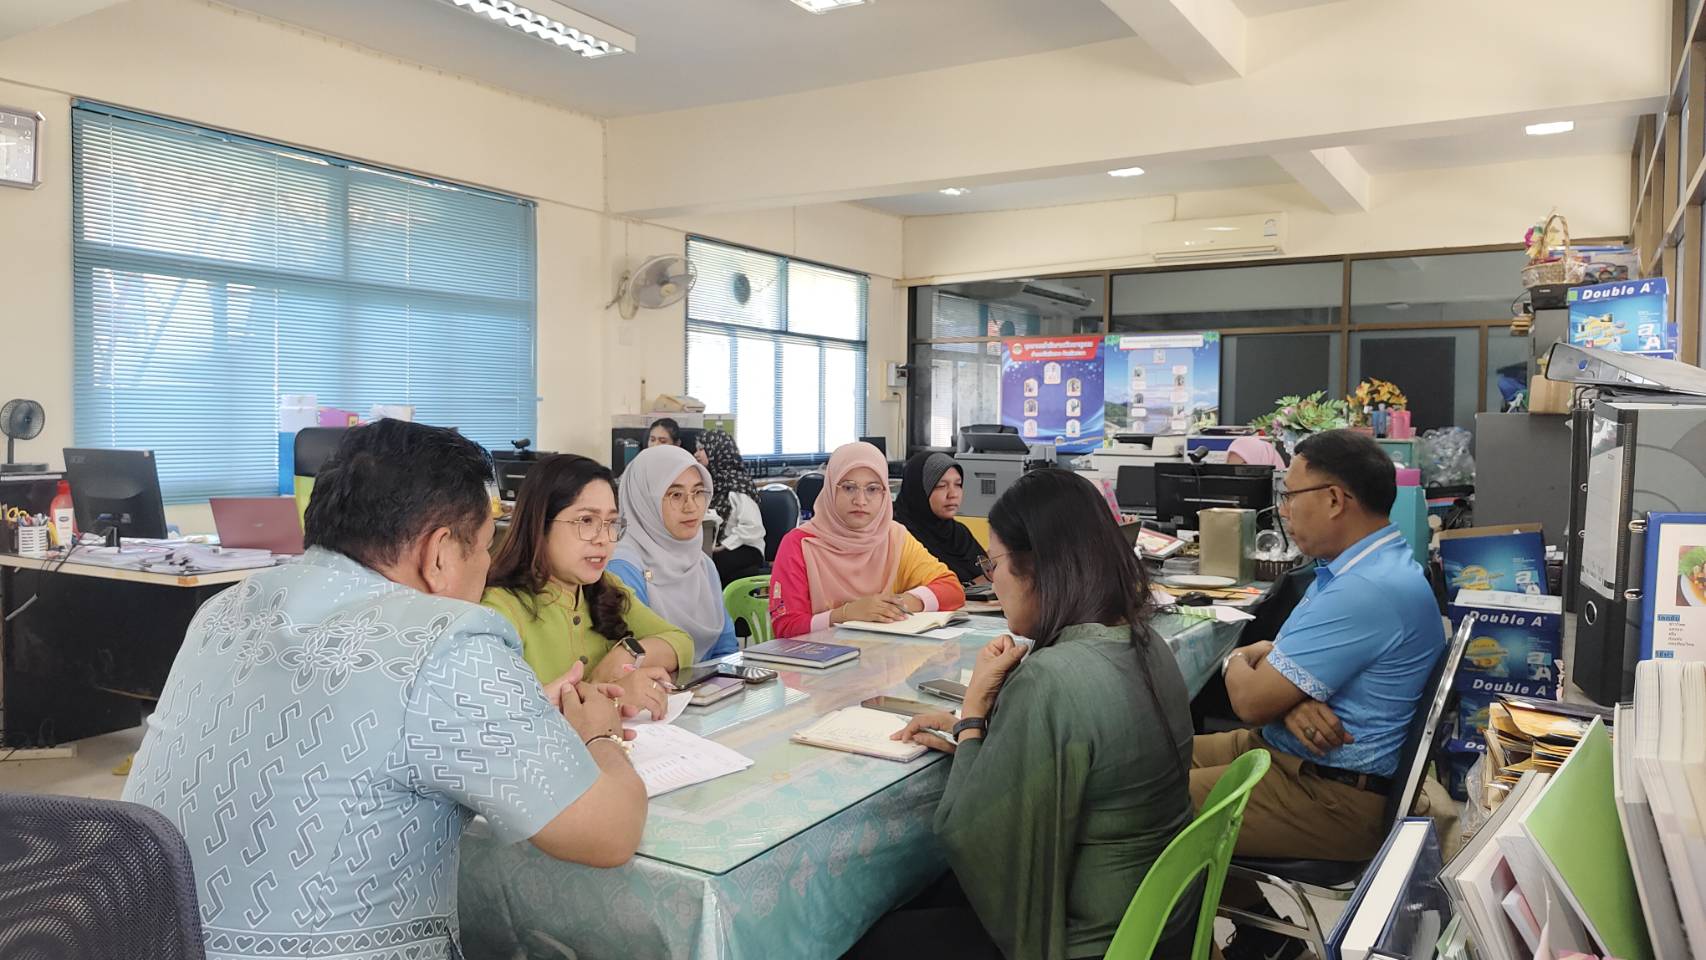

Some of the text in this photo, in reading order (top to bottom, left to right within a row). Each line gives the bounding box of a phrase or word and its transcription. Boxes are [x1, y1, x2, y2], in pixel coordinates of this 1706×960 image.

[1582, 282, 1651, 299] Double A
[1469, 610, 1543, 627] Double A
[1472, 679, 1547, 697] Double A
